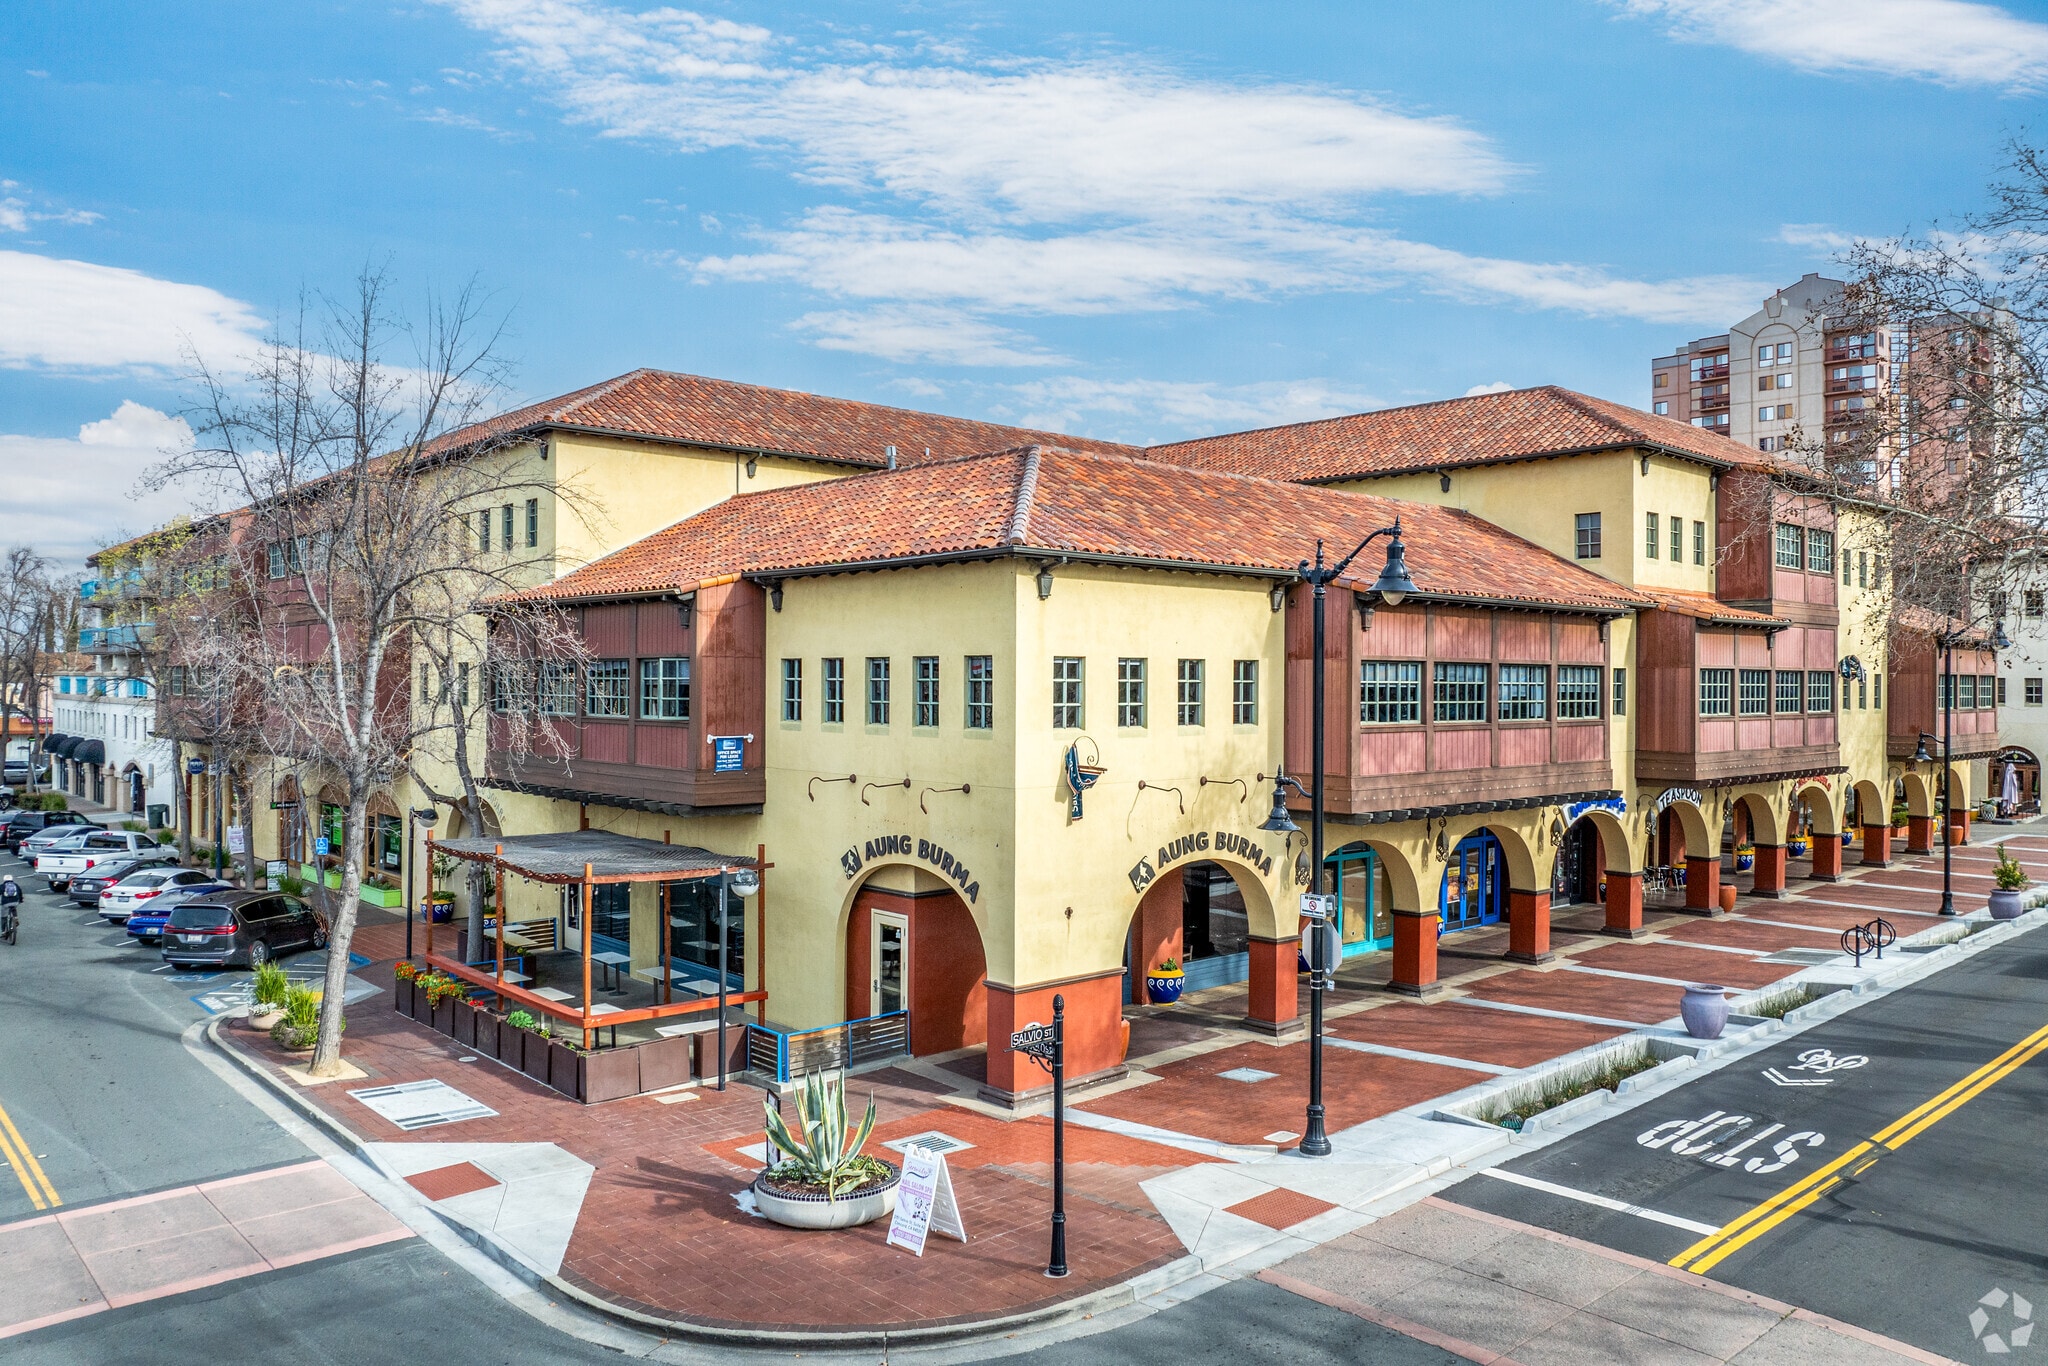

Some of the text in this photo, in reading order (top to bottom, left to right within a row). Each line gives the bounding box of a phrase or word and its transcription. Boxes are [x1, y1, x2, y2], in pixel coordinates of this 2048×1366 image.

[1660, 787, 1703, 809] TEASPOON
[865, 834, 980, 904] AUNG BURMA
[1158, 831, 1272, 877] AUNG BURMA
[1013, 1028, 1052, 1046] SALVIO ST
[1636, 1110, 1825, 1174] STOP
[902, 1178, 933, 1194] NAIL SALON SPA
